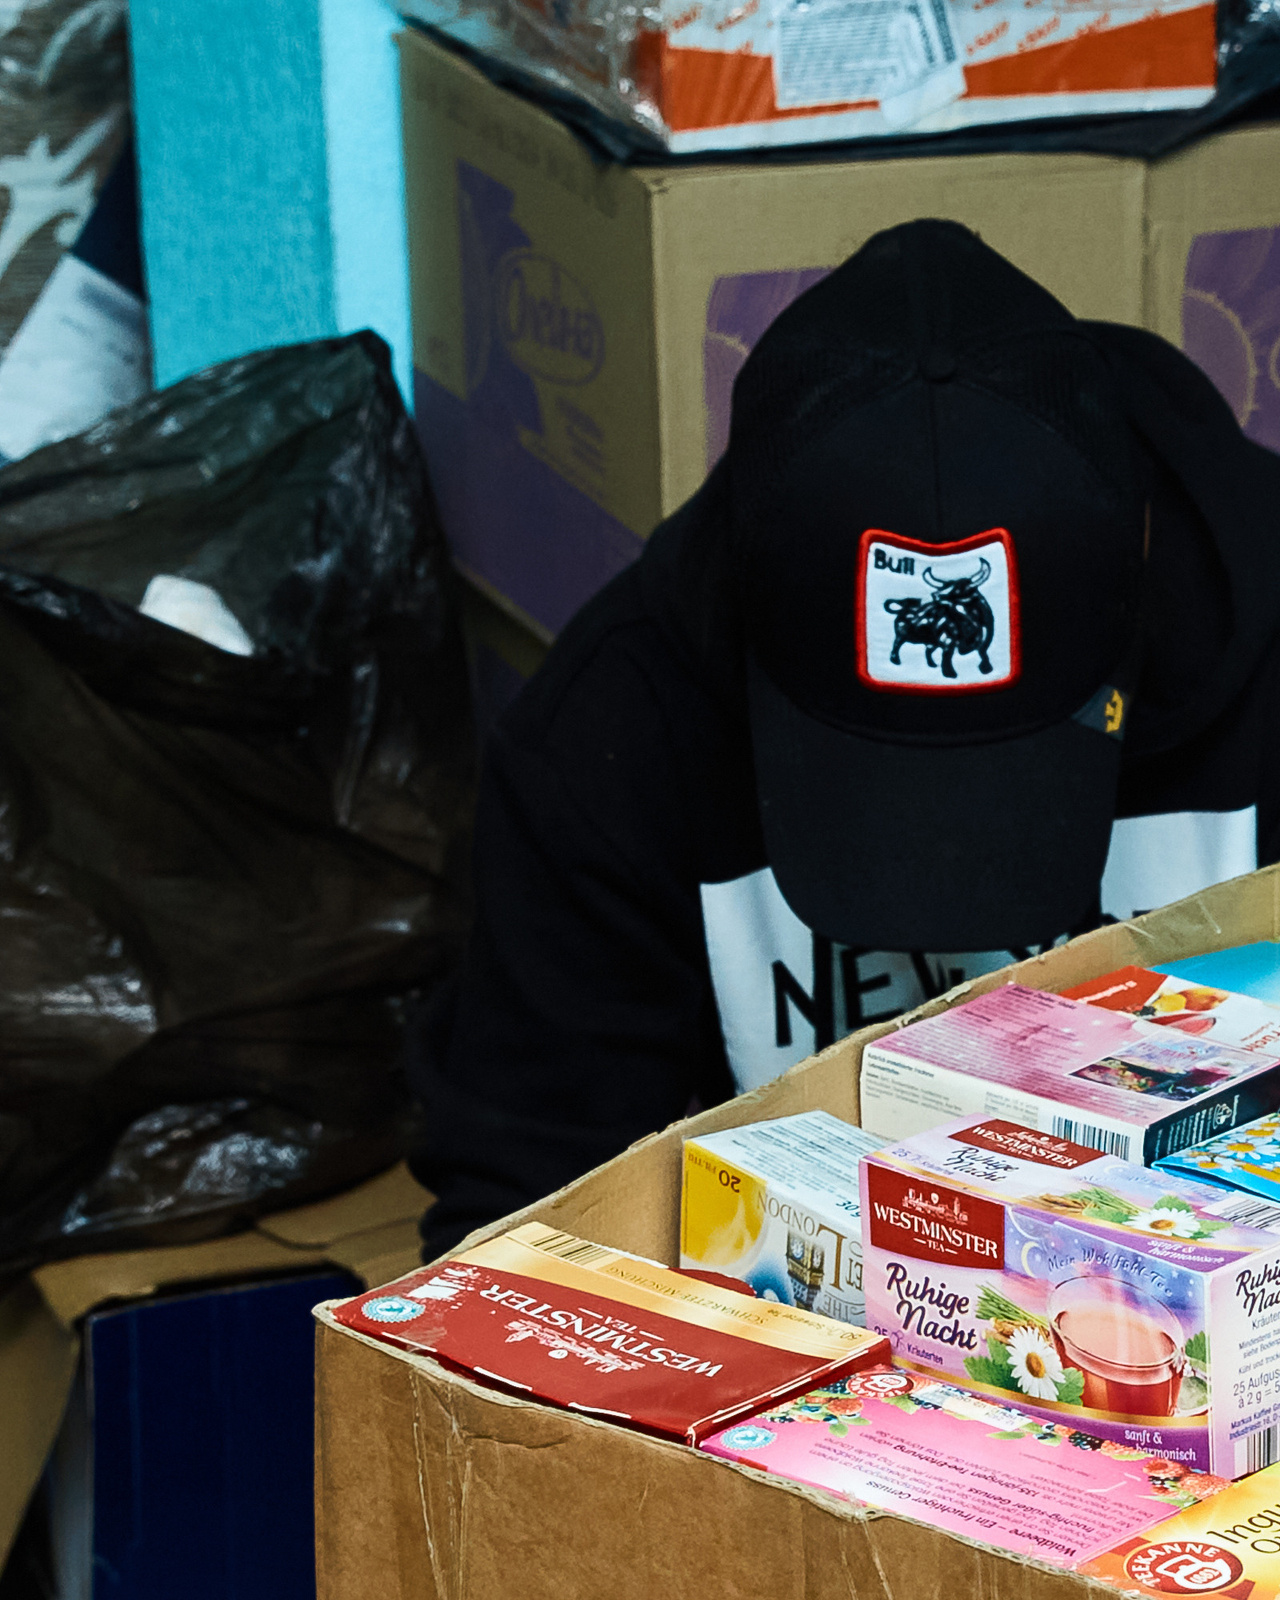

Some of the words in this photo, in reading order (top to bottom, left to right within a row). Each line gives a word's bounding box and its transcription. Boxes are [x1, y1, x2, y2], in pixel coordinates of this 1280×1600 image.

[873, 548, 916, 576] Bull
[972, 1125, 1079, 1169] WESTMINSTER
[718, 1169, 741, 1194] 20
[873, 1200, 998, 1260] WESTMINSTER
[925, 1238, 946, 1255] TEA
[1046, 1248, 1076, 1279] Mein
[884, 1258, 972, 1327] Ruhige
[478, 1282, 725, 1379] WESTMINSTER
[604, 1316, 641, 1336] TEA
[894, 1296, 979, 1355] Nacht
[1233, 1381, 1247, 1397] 25
[1238, 1394, 1245, 1409] à
[1246, 1391, 1254, 1405] 2
[1230, 1413, 1253, 1430] Markus
[1253, 1405, 1272, 1422] Kaffee
[1124, 1423, 1150, 1447] sanft
[1151, 1430, 1162, 1446] &
[891, 1442, 970, 1475] Tee-Erfahrung
[863, 1479, 912, 1500] Genuss
[969, 1467, 1042, 1498] 135-jährigen
[908, 1493, 977, 1522] fruchtiger
[1010, 1499, 1097, 1534] fruchtig-süßer
[972, 1516, 997, 1529] Ein
[1004, 1527, 1079, 1557] Waldbeere
[1129, 1542, 1222, 1589] TEEKANNE
